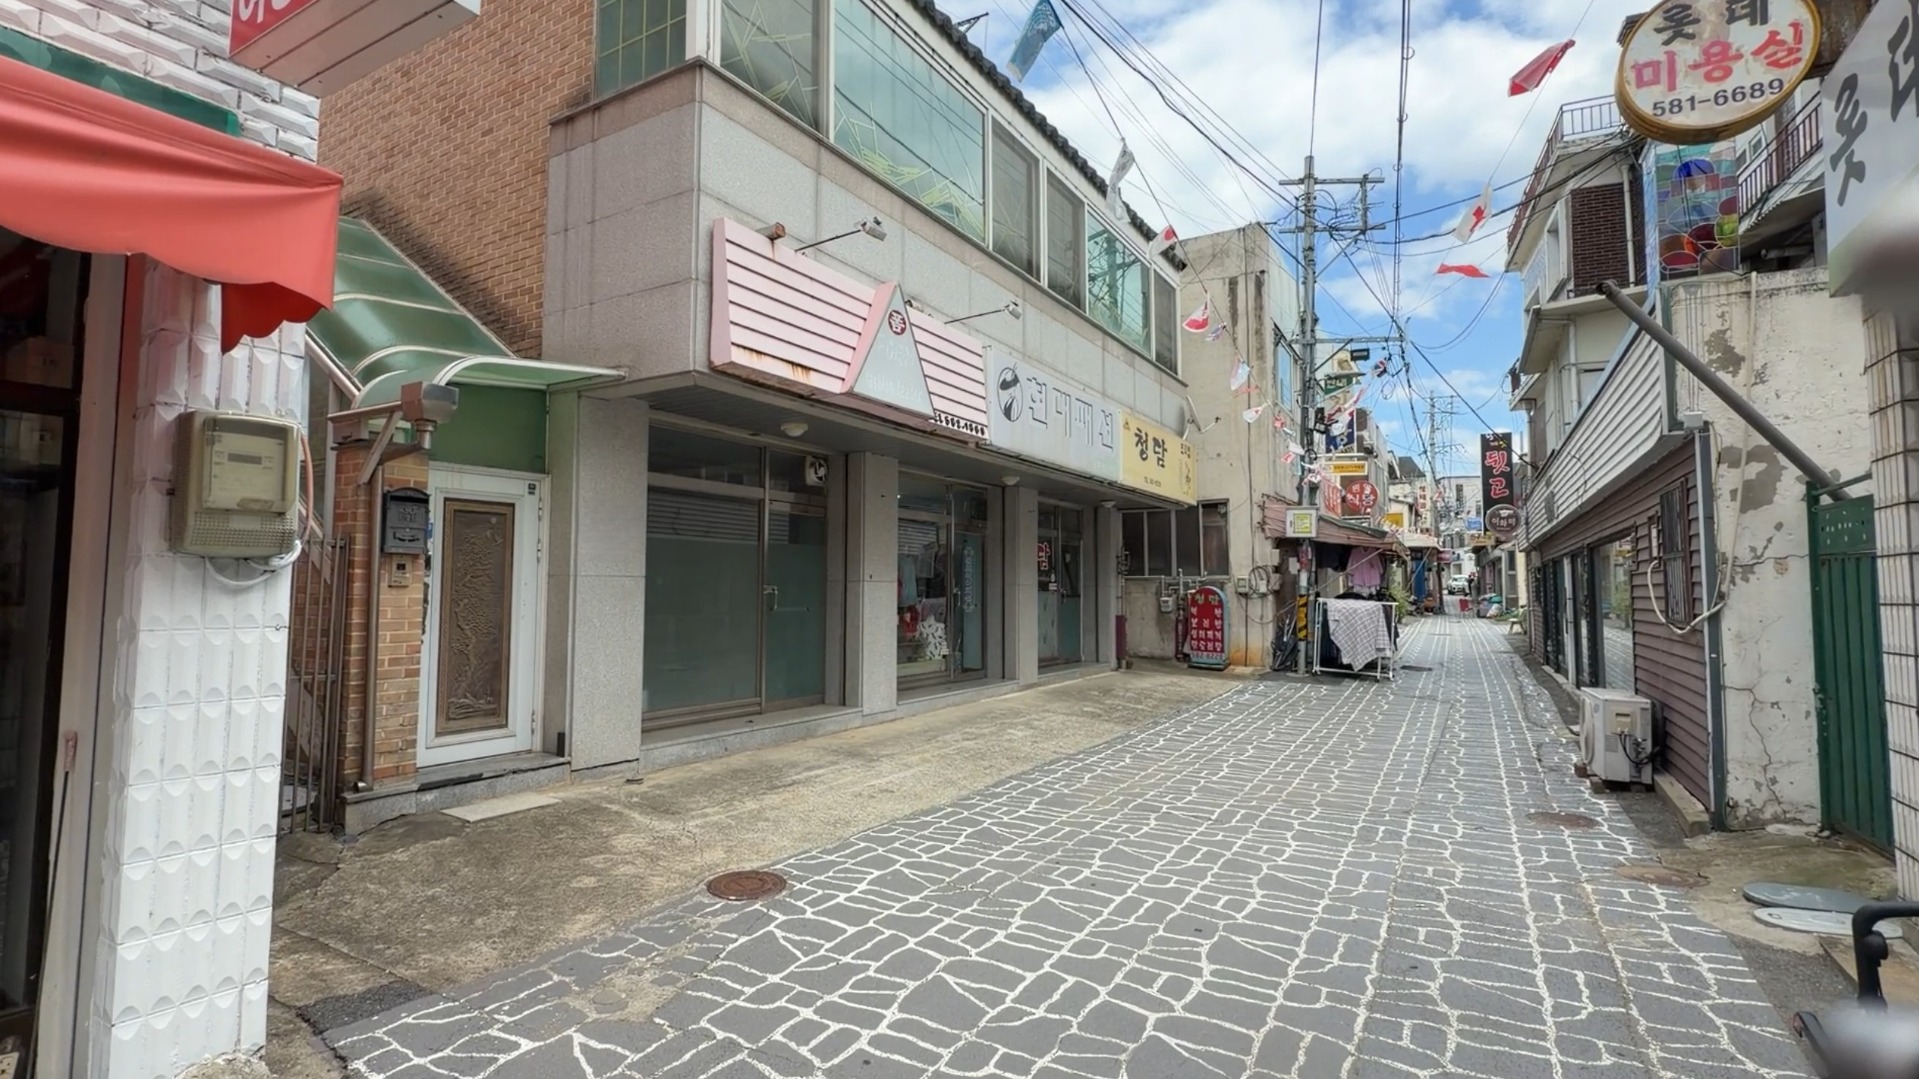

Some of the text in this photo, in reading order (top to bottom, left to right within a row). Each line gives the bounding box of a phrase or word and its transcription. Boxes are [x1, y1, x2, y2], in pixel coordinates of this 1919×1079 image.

[1653, 0, 1769, 46] 롯데
[1630, 19, 1804, 92] 미용실
[1651, 77, 1785, 118] 581-6689
[1025, 376, 1114, 454] 현대패션
[1134, 427, 1168, 469] 청담
